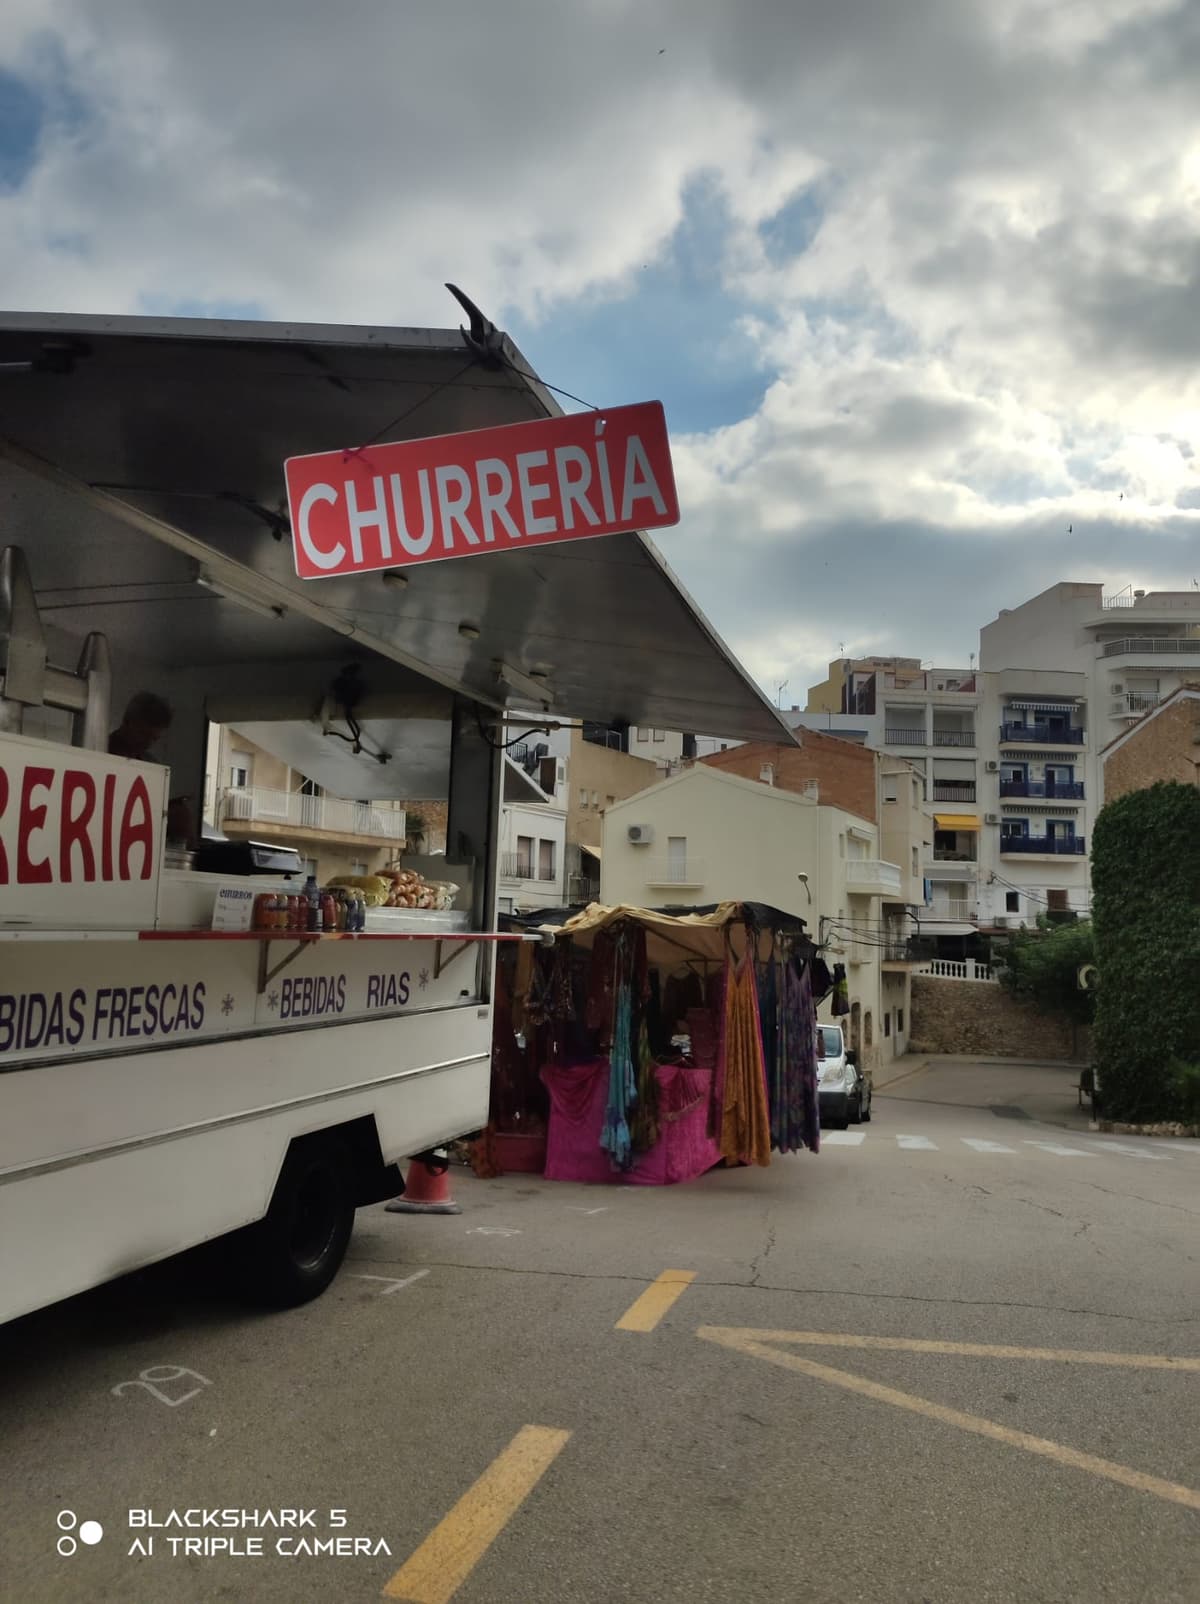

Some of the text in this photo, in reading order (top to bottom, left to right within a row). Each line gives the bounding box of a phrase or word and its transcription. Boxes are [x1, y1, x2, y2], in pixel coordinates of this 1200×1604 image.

[298, 418, 668, 570] CHURRERÍA
[92, 981, 206, 1040] FRESCAS
[279, 971, 411, 1019] BEBIDAS RIAS
